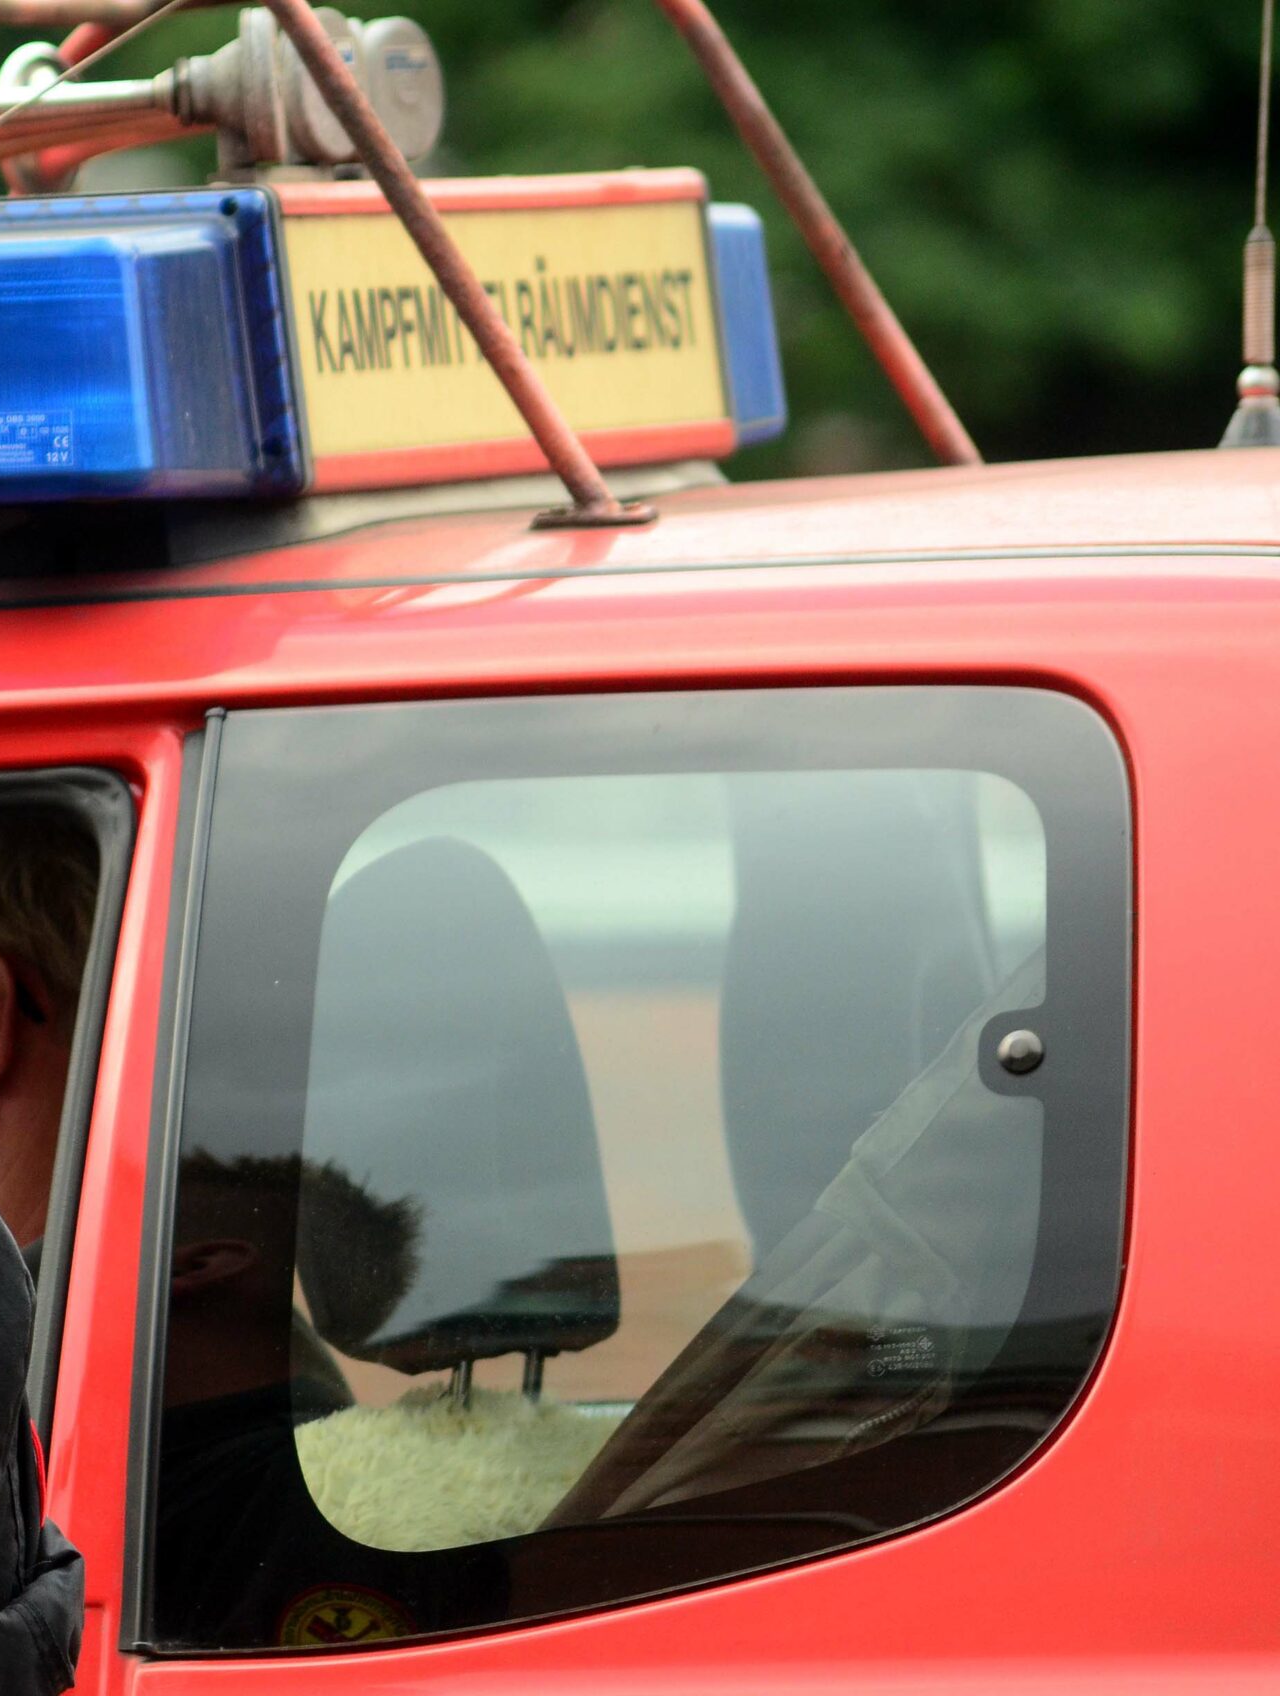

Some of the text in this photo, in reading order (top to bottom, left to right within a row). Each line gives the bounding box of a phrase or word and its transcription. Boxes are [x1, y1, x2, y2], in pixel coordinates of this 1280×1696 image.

[308, 255, 696, 374] KAMPFMITRÄUMDIENST
[47, 452, 58, 463] 12
[60, 451, 68, 462] V
